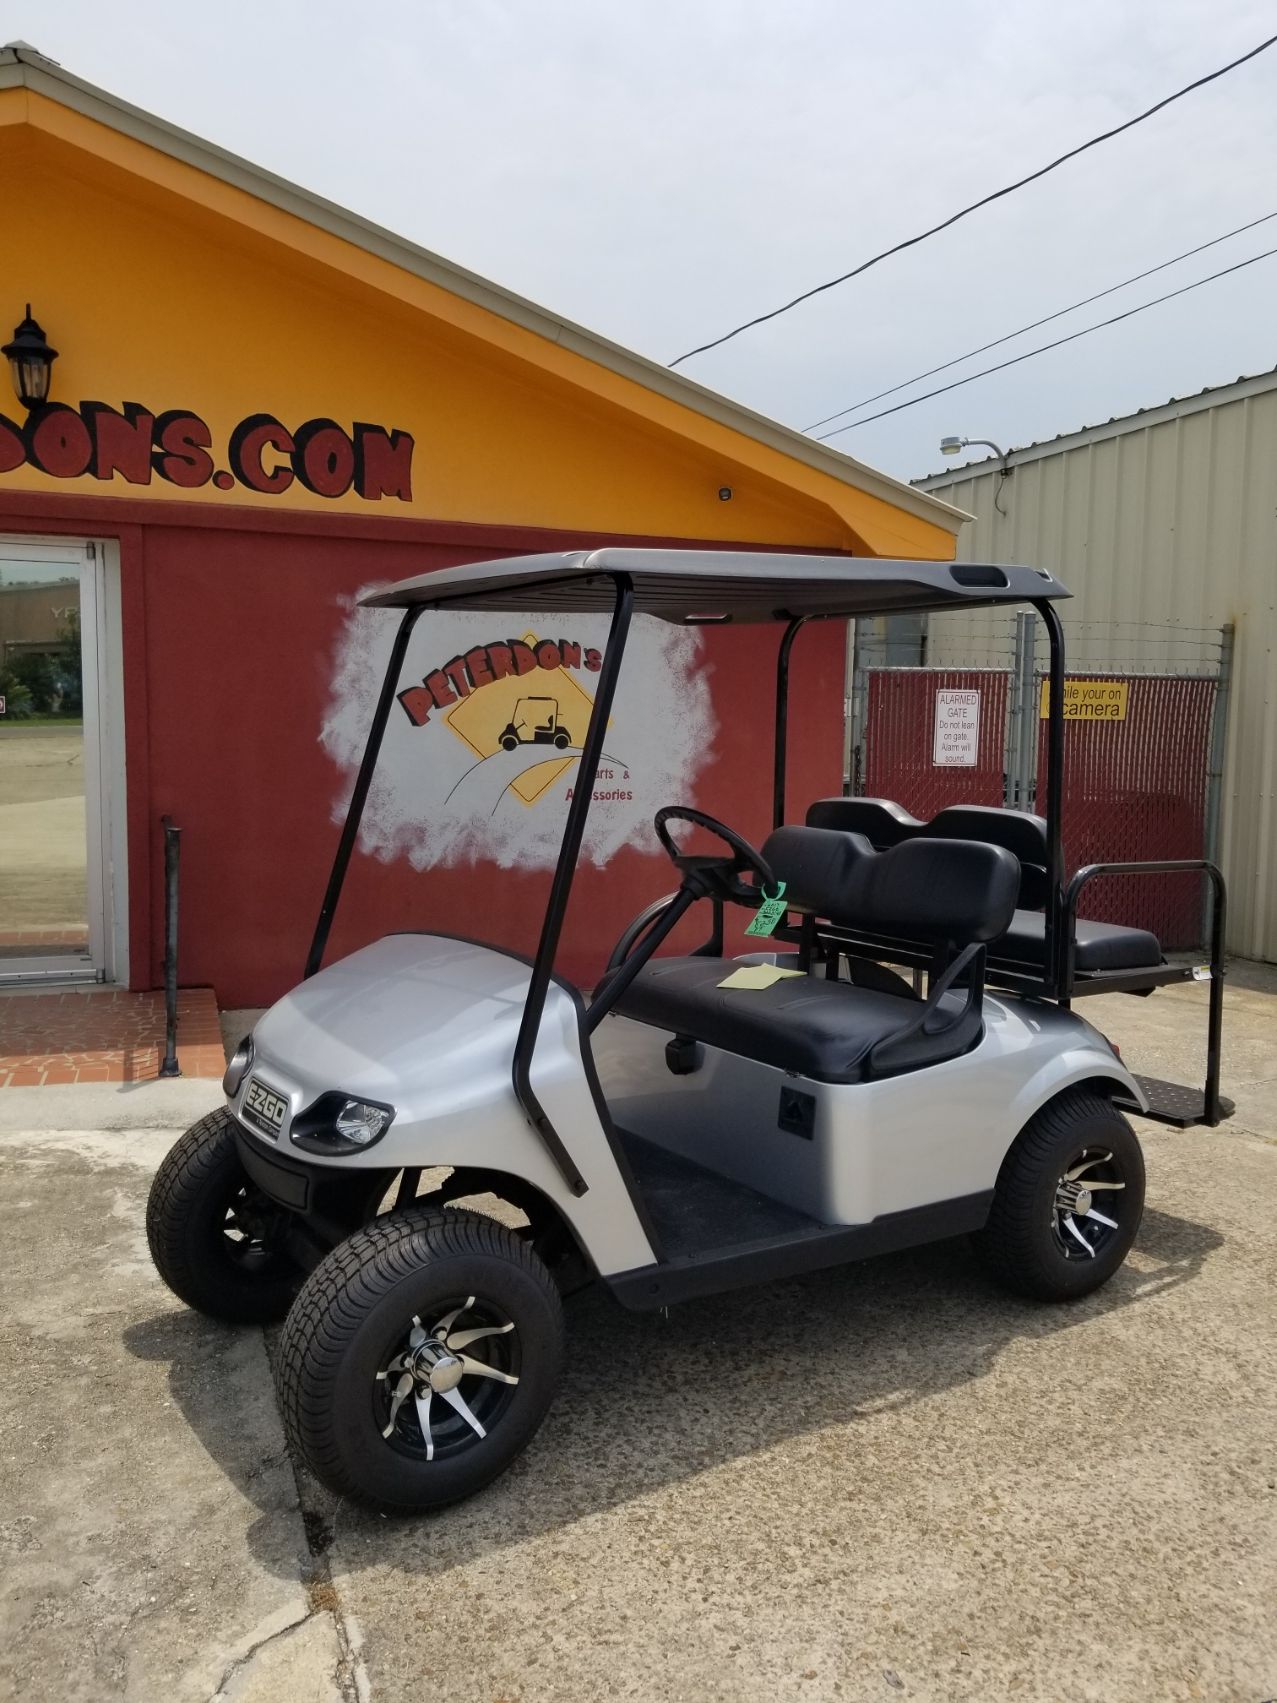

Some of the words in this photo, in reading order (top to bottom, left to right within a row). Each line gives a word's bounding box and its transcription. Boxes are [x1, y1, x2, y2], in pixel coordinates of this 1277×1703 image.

[940, 694, 977, 705] ALARMED
[1082, 689, 1106, 702] your
[1108, 690, 1121, 700] on
[947, 708, 968, 718] GATE
[1062, 703, 1120, 716] camera
[939, 720, 949, 729] Do
[950, 721, 960, 730] not
[962, 721, 975, 730] lean
[942, 743, 960, 752] Alarm
[961, 744, 972, 752] will
[594, 768, 614, 779] arts
[565, 788, 633, 801] Assories
